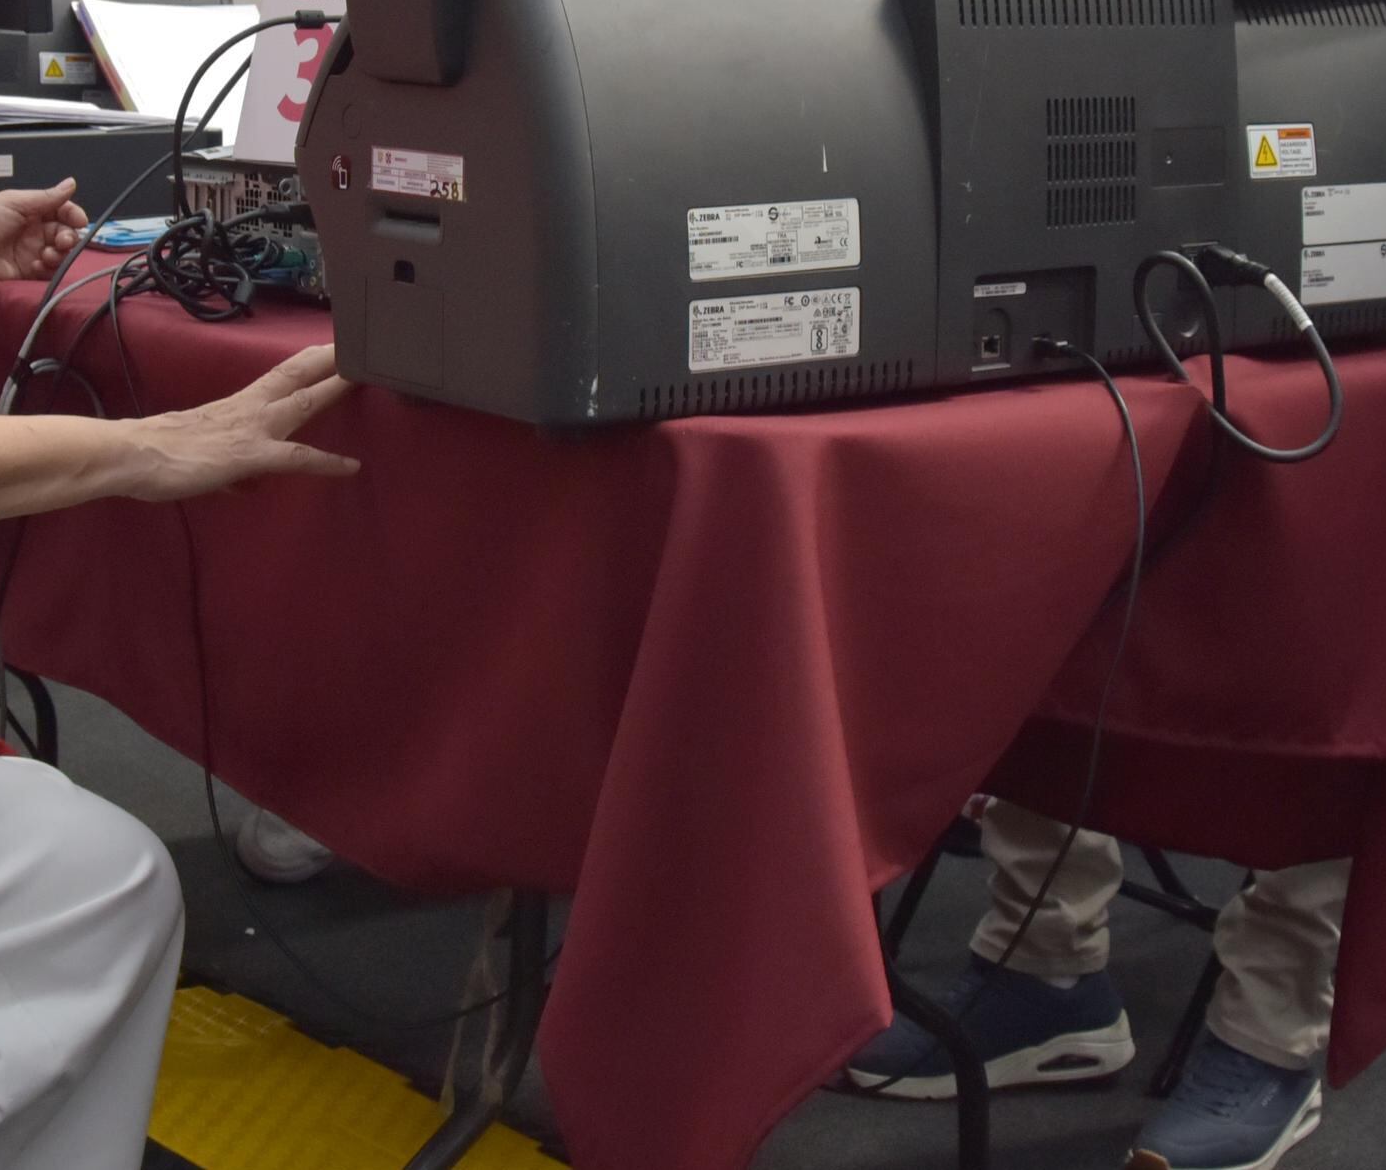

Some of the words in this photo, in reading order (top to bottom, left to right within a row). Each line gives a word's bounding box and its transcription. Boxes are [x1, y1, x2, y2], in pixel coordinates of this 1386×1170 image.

[430, 180, 460, 201] 258
[700, 213, 720, 221] ZEBRA
[703, 306, 724, 315] ZEBRA
